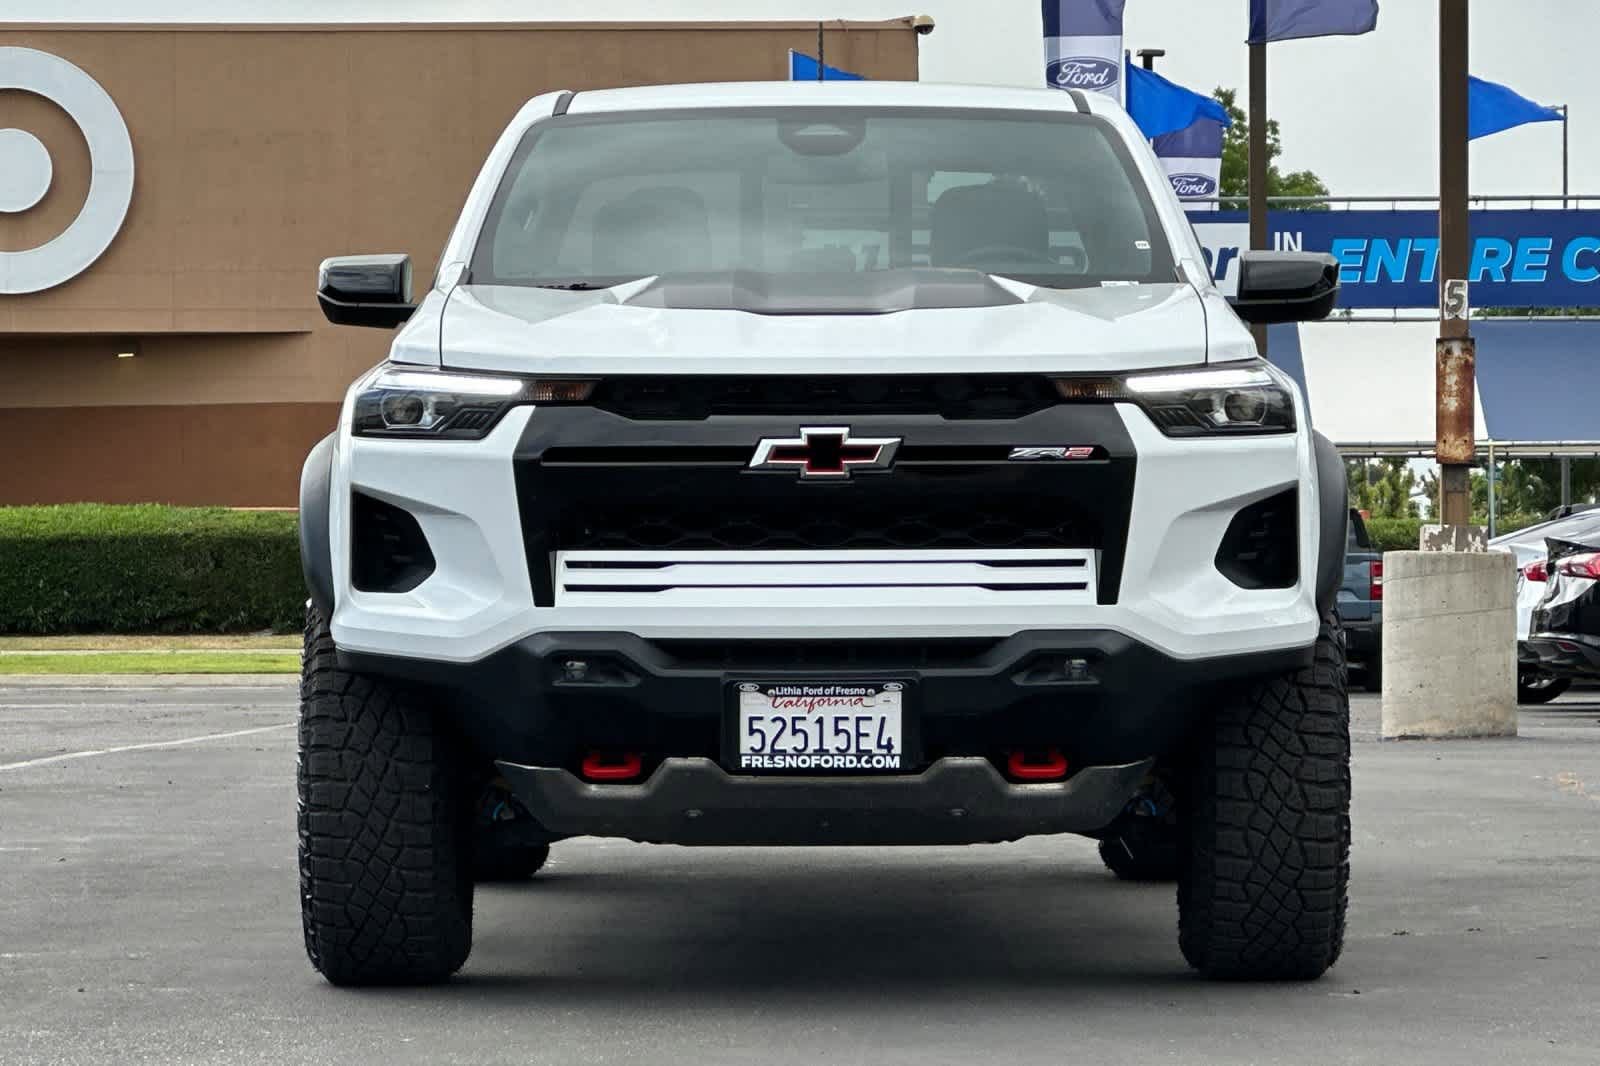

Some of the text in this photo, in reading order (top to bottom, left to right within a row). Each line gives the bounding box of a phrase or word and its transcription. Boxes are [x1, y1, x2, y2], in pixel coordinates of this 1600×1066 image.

[1056, 61, 1109, 85] Ford
[1172, 176, 1208, 195] Ford
[1273, 231, 1303, 252] IN
[1330, 238, 1553, 283] ENTRE
[1444, 281, 1466, 316] 5
[775, 686, 866, 696] Lithia Ford of Fresno
[770, 696, 875, 714] California
[748, 716, 894, 753] 52515E4
[741, 755, 900, 769] FRESNOFORD.COM
